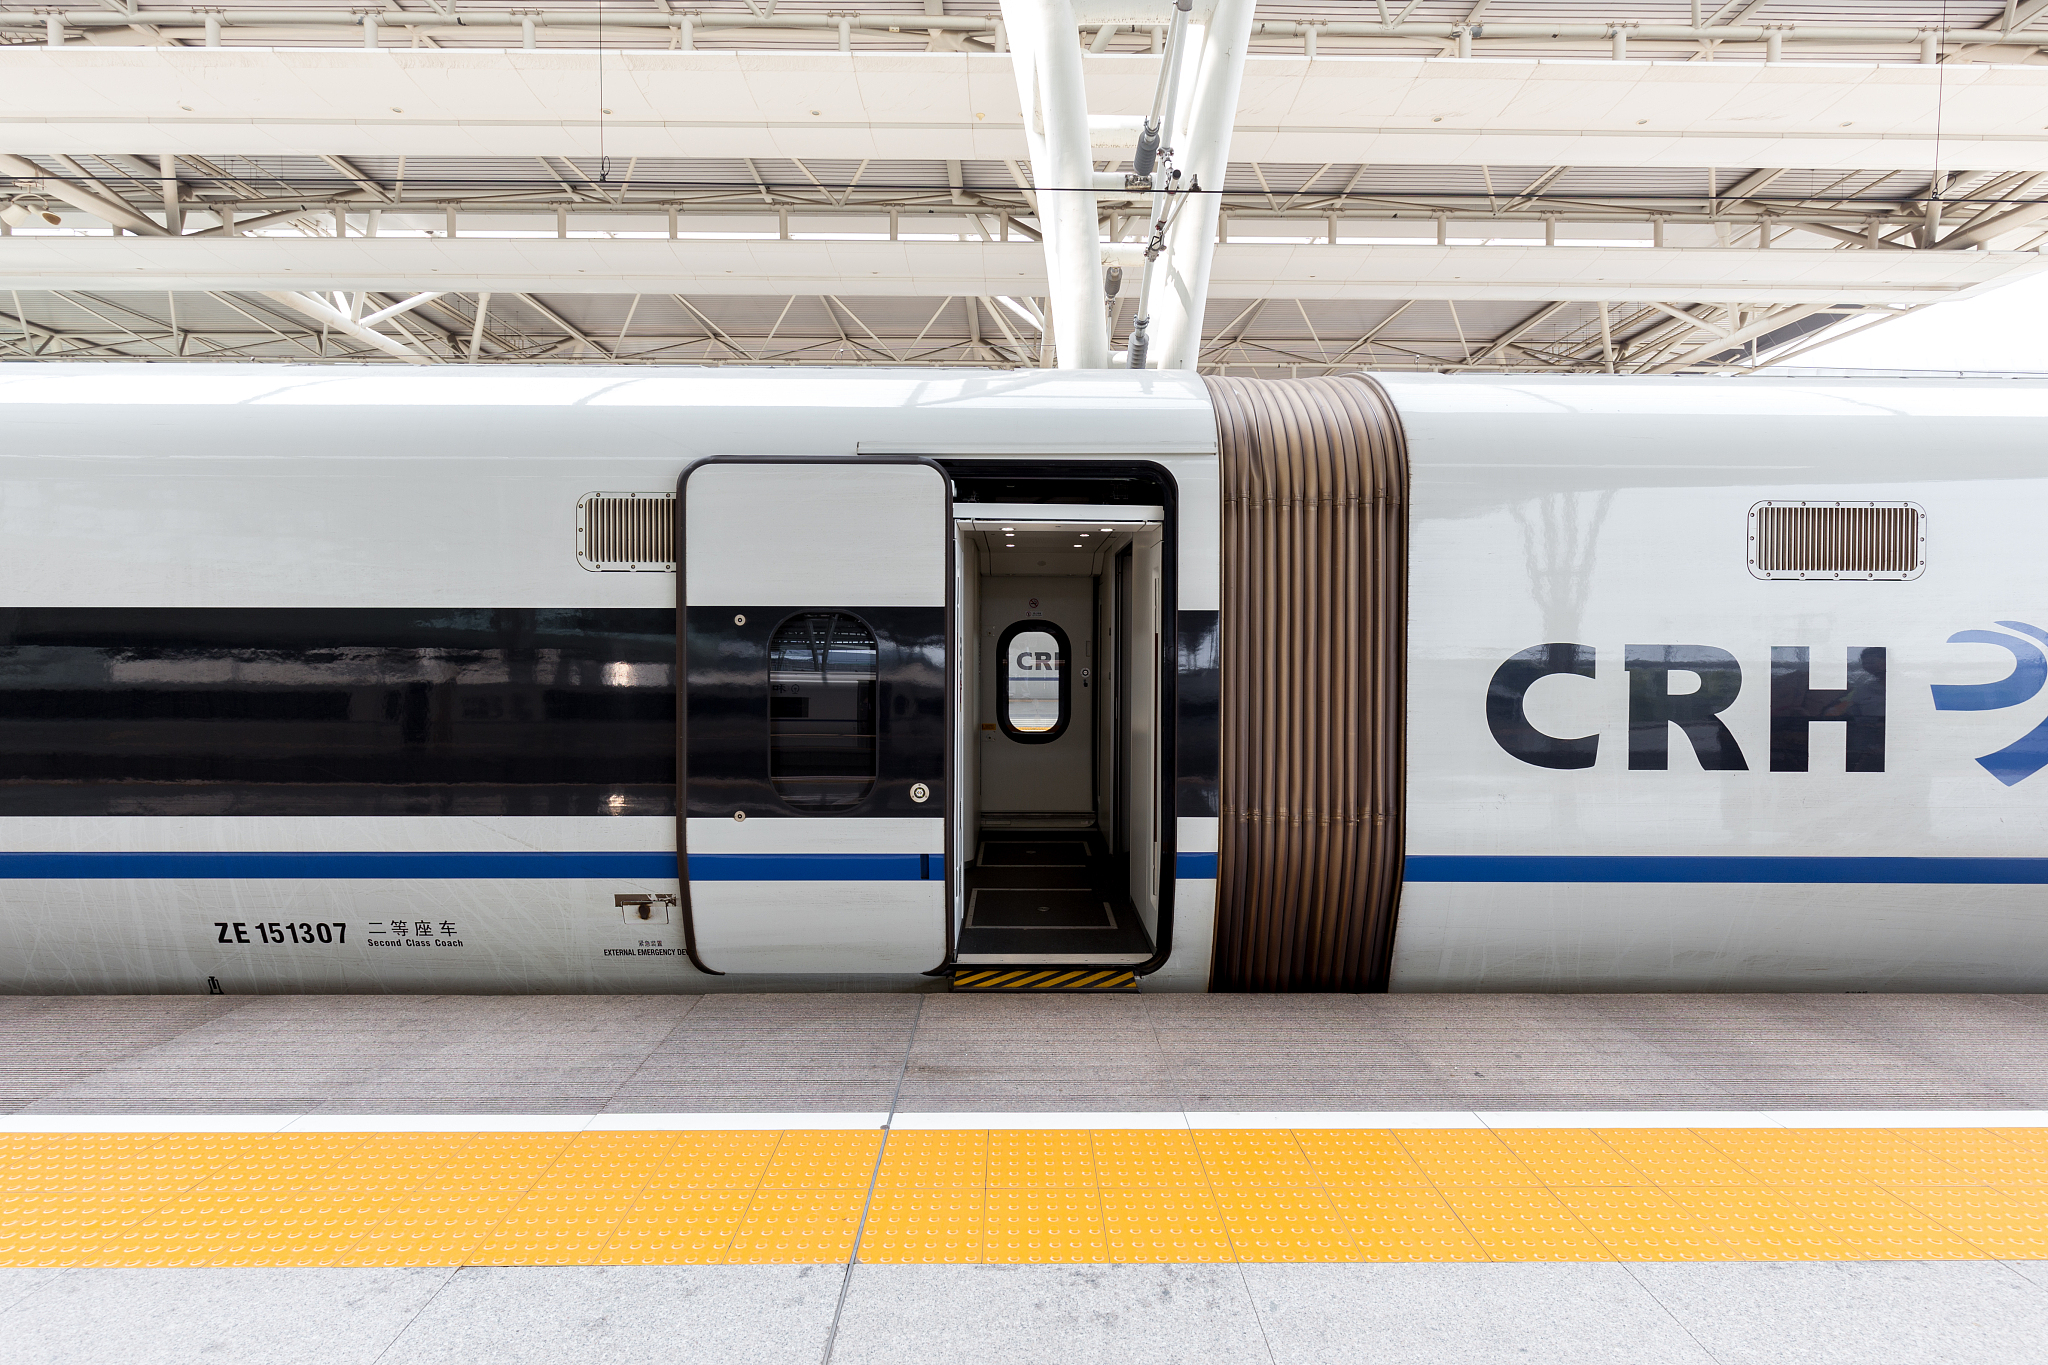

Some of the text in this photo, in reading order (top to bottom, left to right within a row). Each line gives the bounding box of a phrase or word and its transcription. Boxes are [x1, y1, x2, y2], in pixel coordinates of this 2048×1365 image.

[1486, 642, 1887, 773] CRH
[214, 922, 346, 944] ZE 151307
[368, 920, 458, 937] 二等座车
[367, 938, 464, 947] Second Class Coach
